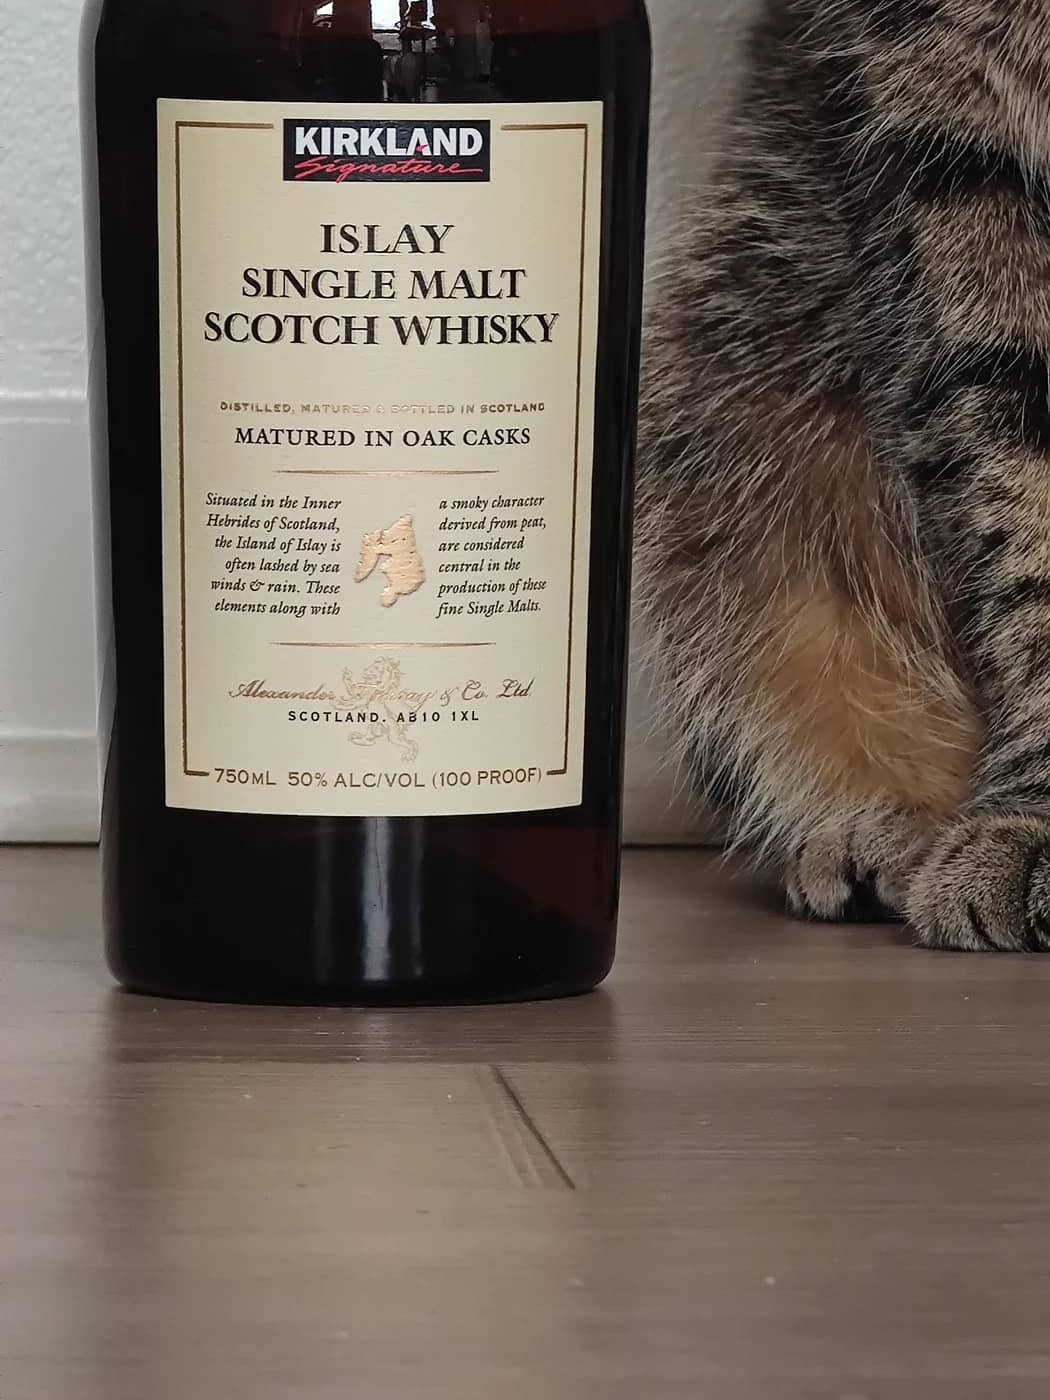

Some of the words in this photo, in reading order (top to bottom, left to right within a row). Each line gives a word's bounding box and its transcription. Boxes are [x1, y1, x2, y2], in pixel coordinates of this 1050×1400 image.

[294, 126, 484, 157] KIRKLAND
[293, 155, 484, 183] Signature
[319, 223, 455, 255] ISLAY
[241, 267, 397, 300] SINGLE
[407, 269, 527, 300] MALT
[203, 311, 380, 346] SCOTCH
[388, 312, 560, 346] WHISKY
[220, 401, 296, 415] DISTILLED,
[301, 403, 370, 415] MATURED
[460, 404, 475, 414] IN
[480, 402, 545, 414] SCOTLAND
[234, 427, 356, 447] MATURED
[364, 429, 394, 447] IN
[402, 429, 456, 447] OAK
[462, 427, 531, 447] CASKS
[205, 492, 258, 507] Situated
[261, 494, 275, 508] in
[279, 495, 299, 509] the
[302, 495, 342, 510] Inner
[439, 498, 448, 509] a
[450, 495, 489, 512] smoky
[491, 495, 545, 509] character
[206, 513, 261, 528] Hebrides
[263, 516, 279, 533] of
[278, 516, 340, 534] Scotland,
[438, 517, 487, 531] derived
[486, 516, 518, 533] from
[519, 516, 547, 532] peat,
[214, 534, 233, 548] the
[236, 535, 277, 550] Island
[279, 538, 296, 554] of
[295, 538, 328, 555] Islay
[330, 538, 342, 552] is
[438, 541, 461, 552] are
[463, 535, 525, 552] considered
[224, 556, 256, 574] often
[259, 557, 300, 573] lashed
[302, 559, 318, 576] by
[319, 563, 341, 573] sea
[438, 558, 485, 573] central
[487, 558, 501, 572] in
[503, 557, 522, 571] the
[210, 577, 247, 591] winds
[249, 578, 266, 592] &
[267, 579, 301, 593] rain.
[305, 579, 341, 594] These
[436, 579, 507, 599] production
[508, 577, 523, 596] of
[522, 576, 548, 591] these
[214, 597, 267, 613] elements
[269, 600, 307, 619] along
[310, 601, 342, 616] with
[434, 601, 464, 620] fine
[466, 600, 505, 618] Single
[506, 598, 542, 614] Malts.
[288, 710, 387, 723] SCOTLAND.
[396, 711, 441, 723] AB10
[452, 710, 480, 722] 1XL
[214, 768, 277, 786] 750ML
[287, 771, 328, 787] 50%
[333, 772, 426, 788] ALC/VOL
[431, 771, 472, 789] (100
[477, 767, 542, 786] PROOF)
